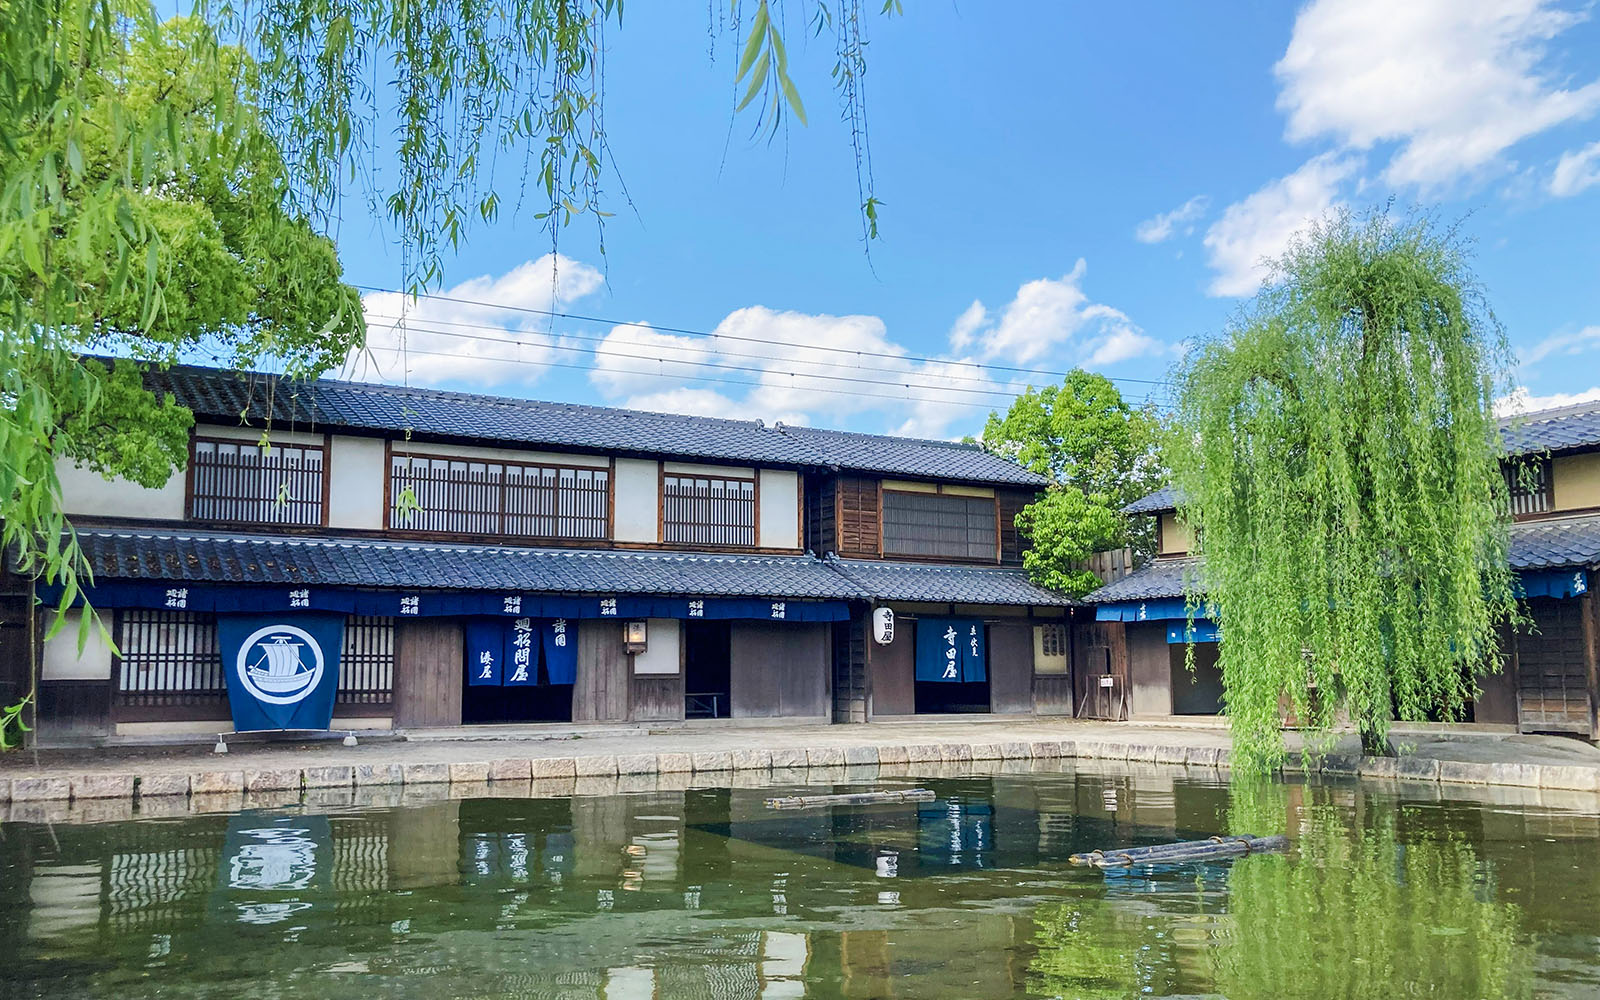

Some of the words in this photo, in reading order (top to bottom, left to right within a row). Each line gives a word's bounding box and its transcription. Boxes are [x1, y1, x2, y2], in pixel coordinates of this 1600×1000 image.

[882, 610, 893, 641] 寺田屋
[942, 625, 958, 679] 寺田屋
